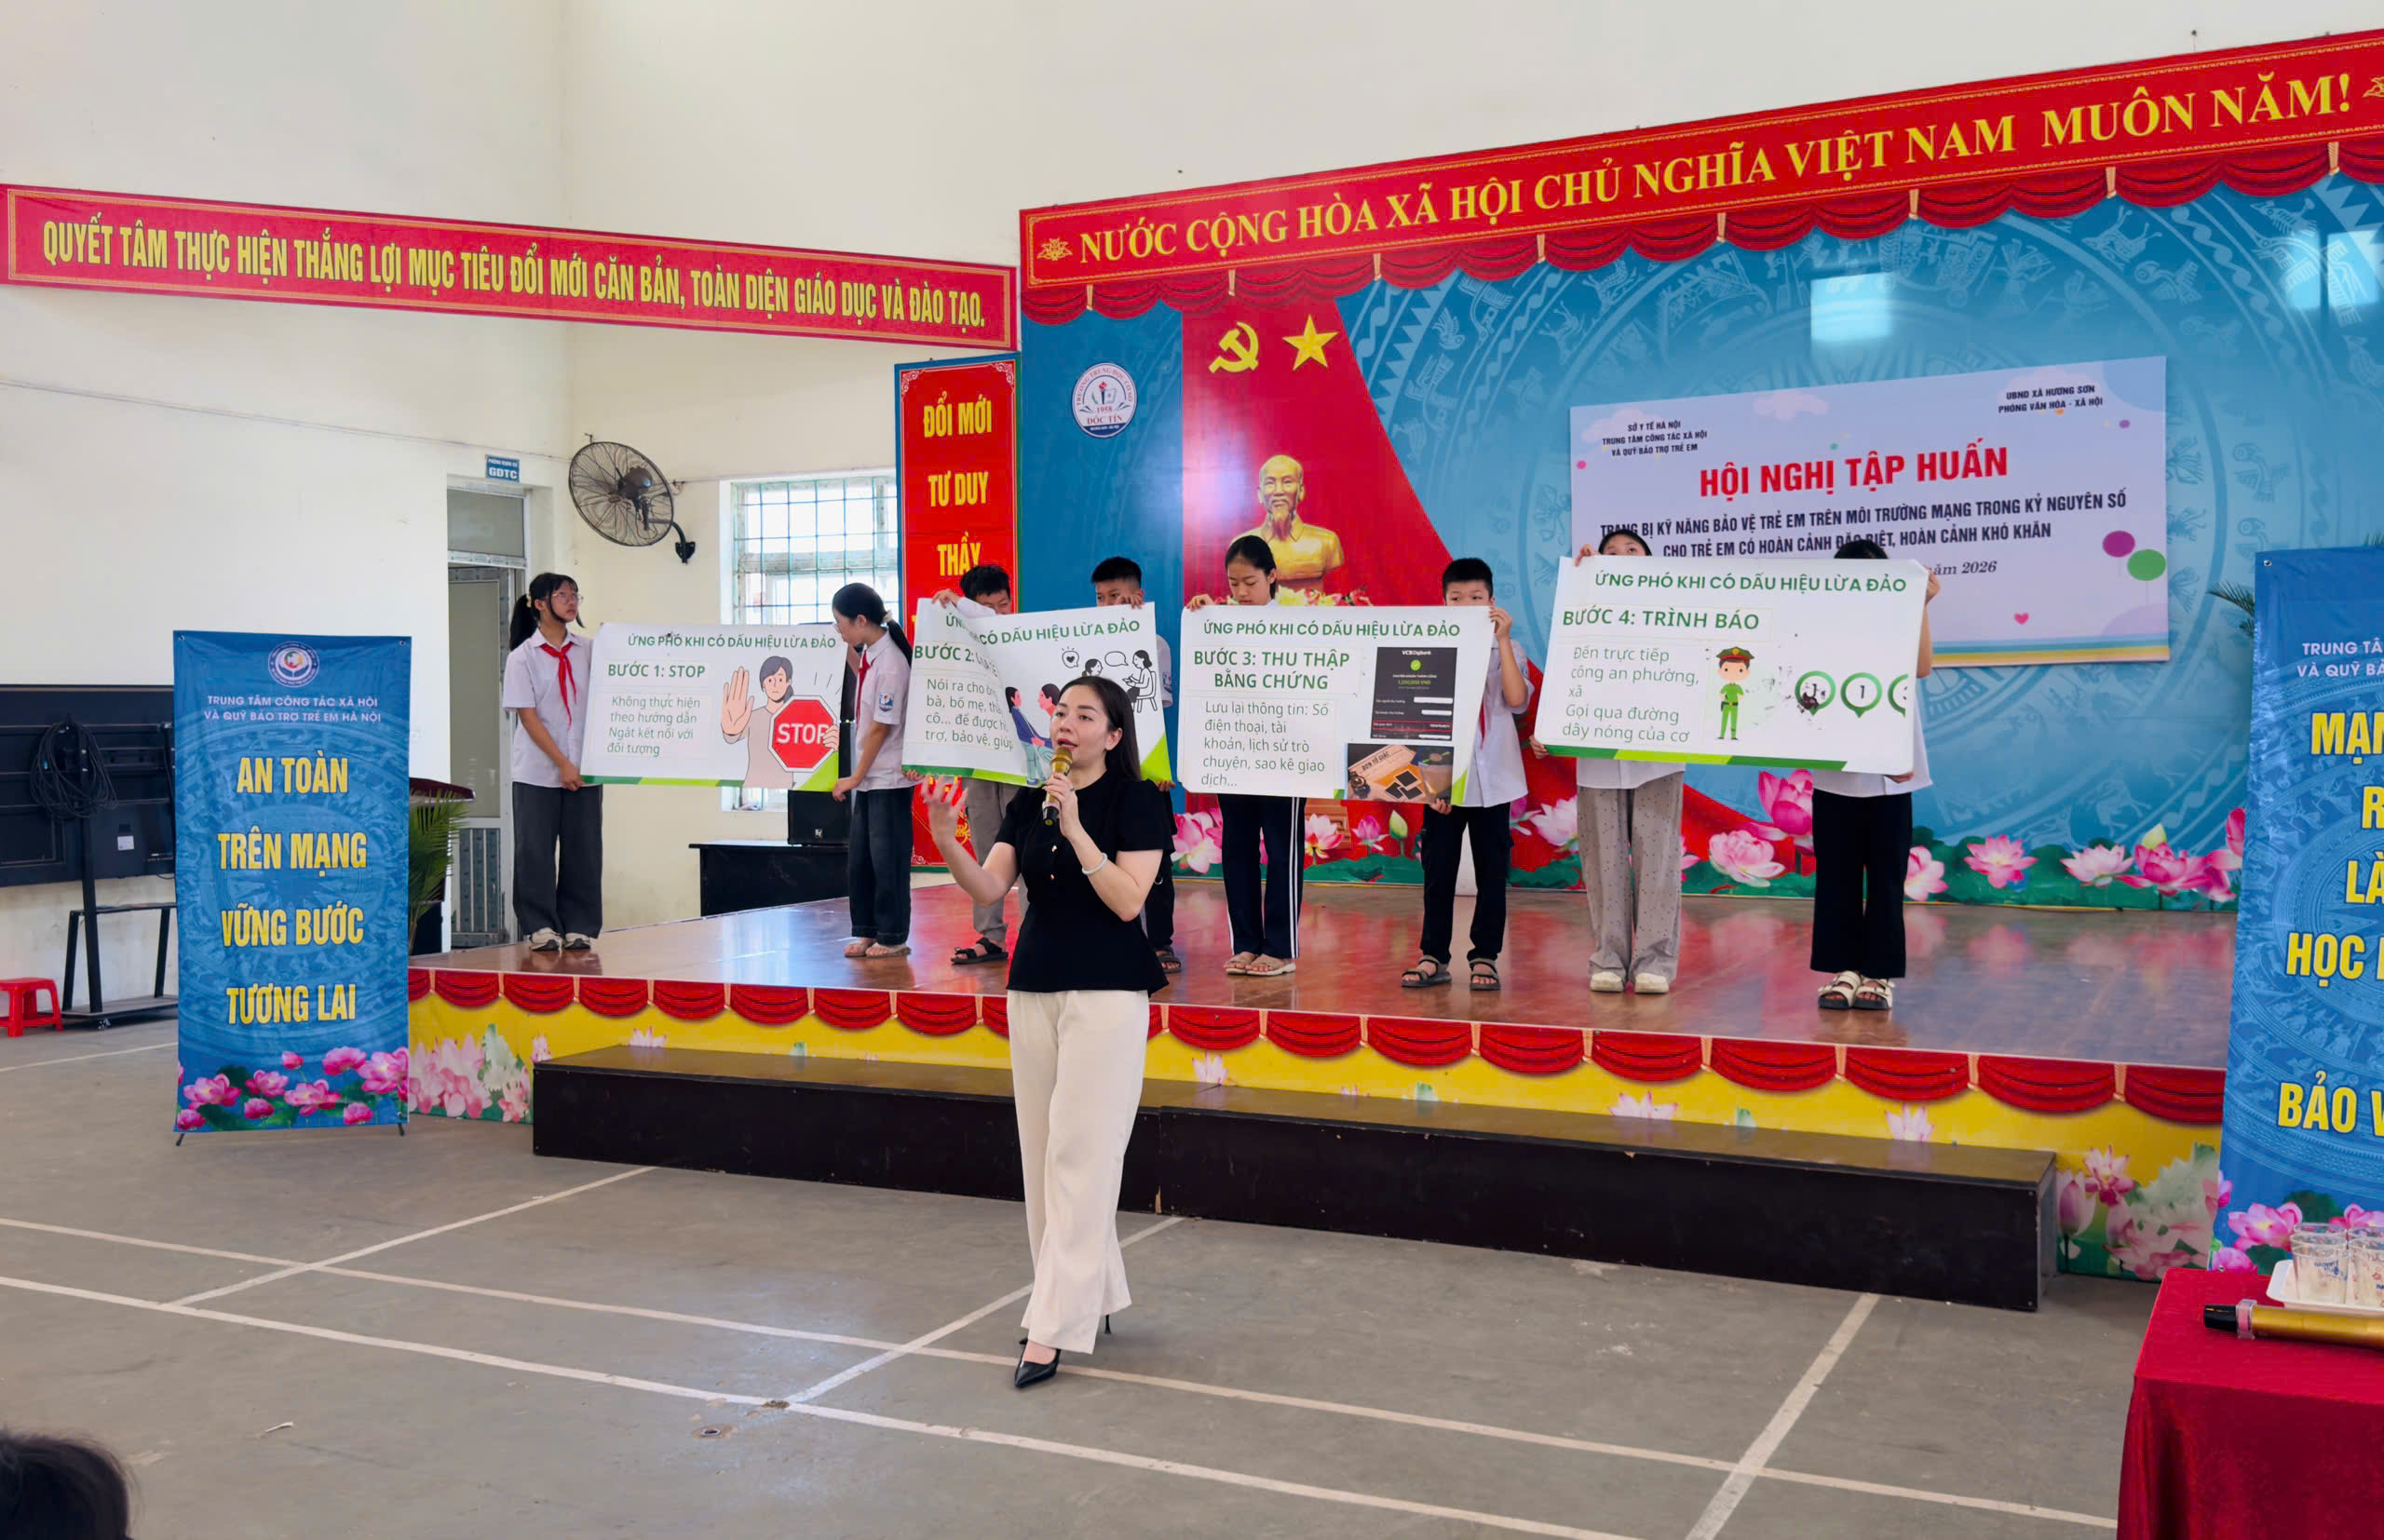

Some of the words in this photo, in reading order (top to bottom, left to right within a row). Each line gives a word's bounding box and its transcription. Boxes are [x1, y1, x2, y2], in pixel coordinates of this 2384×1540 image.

[1080, 218, 1174, 263] NƯỚC
[1187, 210, 1285, 257] CỘNG
[1299, 194, 1376, 238] HÒA
[1388, 183, 1436, 228] XÃ
[1453, 179, 1520, 224] HỘI
[1535, 158, 1620, 209] CHỦ
[1635, 142, 1776, 196] NGHĨA
[1787, 130, 1892, 181] VIỆT
[1907, 116, 2013, 163] NAM
[2043, 86, 2194, 147] MUÔN
[2213, 74, 2350, 127] NĂM!
[44, 212, 113, 265] QUYẾT
[119, 220, 168, 269] TÂM
[173, 230, 231, 280] THỰC
[237, 230, 288, 284] HIỆN
[292, 228, 364, 282] THẮNG
[370, 243, 401, 292] LỢI
[409, 248, 455, 296] MỤC
[460, 245, 506, 291] TIÊU
[509, 240, 545, 299] ĐỔI
[550, 252, 589, 299] MỚI
[594, 256, 634, 302] CĂN
[640, 254, 686, 309] BẢN,
[689, 264, 741, 310] TOÀN
[744, 269, 790, 319] DIỆN
[793, 272, 837, 316] GIÁO
[841, 281, 878, 326] DỤC
[881, 279, 905, 321] VÀ
[908, 282, 945, 324] ĐÀO
[946, 290, 986, 333] TẠO.
[923, 390, 954, 439] ĐỔI
[957, 394, 992, 436] MỚI
[489, 466, 518, 480] GDTC
[1700, 462, 1749, 502] HỘI
[1761, 461, 1834, 495] NGHỊ
[1846, 451, 1905, 492] TẬP
[1918, 439, 2007, 481] HUẤN
[928, 471, 952, 507] TƯ
[954, 471, 989, 506] DUY
[1642, 523, 1654, 539] BỊ
[1658, 520, 1672, 535] KỸ
[1676, 519, 1709, 534] NĂNG
[1714, 514, 1737, 532] BẢO
[1741, 514, 1755, 533] VỆ
[1760, 510, 1781, 529] TRẺ
[1787, 514, 1805, 527] EM
[1809, 509, 1841, 526] TRÊN
[1847, 507, 1870, 523] MÔI
[1875, 504, 1927, 521] TRƯỜNG
[1931, 503, 1971, 520] MẠNG
[1976, 499, 2020, 516] TRONG
[2025, 493, 2041, 512] KỶ
[2047, 492, 2102, 511] NGUYÊN
[2108, 488, 2125, 507] SỐ
[1664, 545, 1686, 556] CHO
[1691, 539, 1712, 556] TRẺ
[1716, 542, 1734, 555] EM
[1740, 538, 1754, 554] CÓ
[1759, 536, 1793, 553] HOÀN
[1797, 534, 1831, 551] CẢNH
[1901, 528, 1936, 546] HOÀN
[1941, 524, 1977, 543] CẢNH
[1982, 522, 2009, 540] KHÓ
[2013, 521, 2051, 539] KHĂN
[1961, 561, 1997, 574] 2026
[1595, 570, 1634, 588] ỨNG
[1637, 572, 1673, 588] PHÓ
[1676, 575, 1706, 589] KHI
[1709, 573, 1736, 589] CÓ
[1740, 573, 1777, 590] DẤU
[1780, 573, 1821, 591] HIỆU
[1824, 574, 1862, 592] LỪA
[1865, 573, 1907, 592] ĐẢO
[1562, 605, 1614, 626] BƯỚC
[1618, 610, 1636, 626] 4:
[1642, 608, 1708, 628] TRÌNH
[1714, 611, 1759, 630] BÁO
[914, 643, 961, 661] BƯỚC
[965, 649, 975, 662] 2:
[1194, 646, 1238, 666] BƯỚC
[1242, 651, 1256, 666] 3:
[1261, 651, 1297, 667] THU
[1303, 648, 1350, 671] THẬP
[1573, 646, 1599, 660] Đến
[1603, 647, 1635, 663] trực
[1639, 647, 1670, 666] tiếp
[2302, 642, 2358, 655] TRUNG
[607, 661, 649, 678] BƯỚC
[654, 664, 665, 678] 1:
[669, 665, 706, 679] STOP
[1214, 669, 1257, 689] BẰNG
[1262, 670, 1328, 690] CHỨNG
[1570, 664, 1605, 682] công
[1608, 669, 1628, 680] an
[1632, 667, 1700, 687] phường,
[2297, 662, 2319, 677] VÀ
[2325, 661, 2360, 677] QUỸ
[1204, 718, 1231, 734] điện
[1234, 719, 1267, 736] thoại,
[1270, 720, 1287, 734] tài
[1565, 703, 1589, 720] Gọi
[1593, 707, 1623, 723] qua
[1627, 706, 1680, 726] đường
[1562, 722, 1590, 741] dây
[1593, 724, 1633, 744] nóng
[1638, 725, 1666, 742] của
[1670, 731, 1690, 743] cơ
[237, 757, 273, 793] AN
[281, 750, 348, 794] TOÀN
[217, 825, 282, 870] TRÊN
[290, 832, 367, 877] MẠNG
[221, 903, 287, 948] VỮNG
[295, 901, 364, 946] BƯỚC
[2286, 932, 2365, 988] HỌC
[226, 983, 309, 1025] TƯƠNG
[318, 984, 357, 1022] LAI
[2278, 1071, 2357, 1134] BẢO
